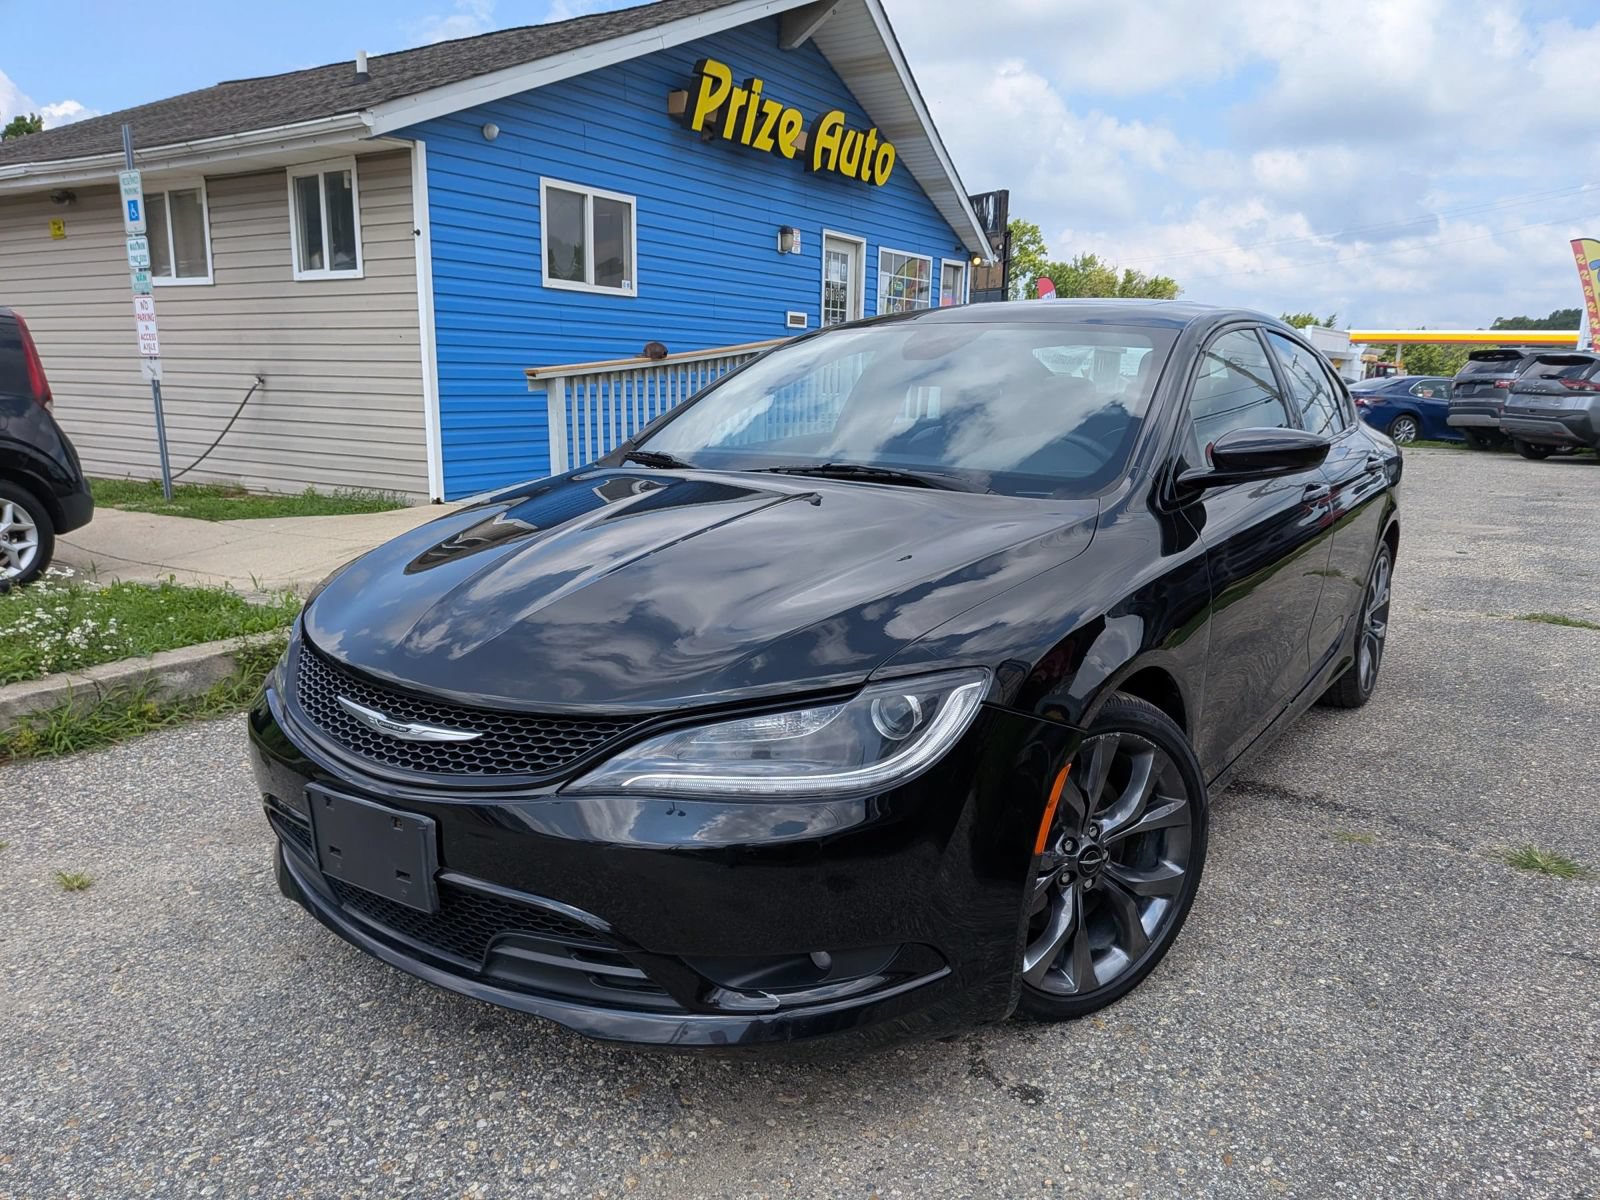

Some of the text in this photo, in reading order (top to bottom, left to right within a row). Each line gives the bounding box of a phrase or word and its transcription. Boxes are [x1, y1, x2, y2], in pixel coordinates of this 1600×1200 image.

[691, 57, 896, 187] Prize Auto
[140, 301, 149, 310] NO
[136, 313, 155, 322] PARKING
[141, 333, 156, 341] ACCESS
[143, 343, 156, 351] AISLE
